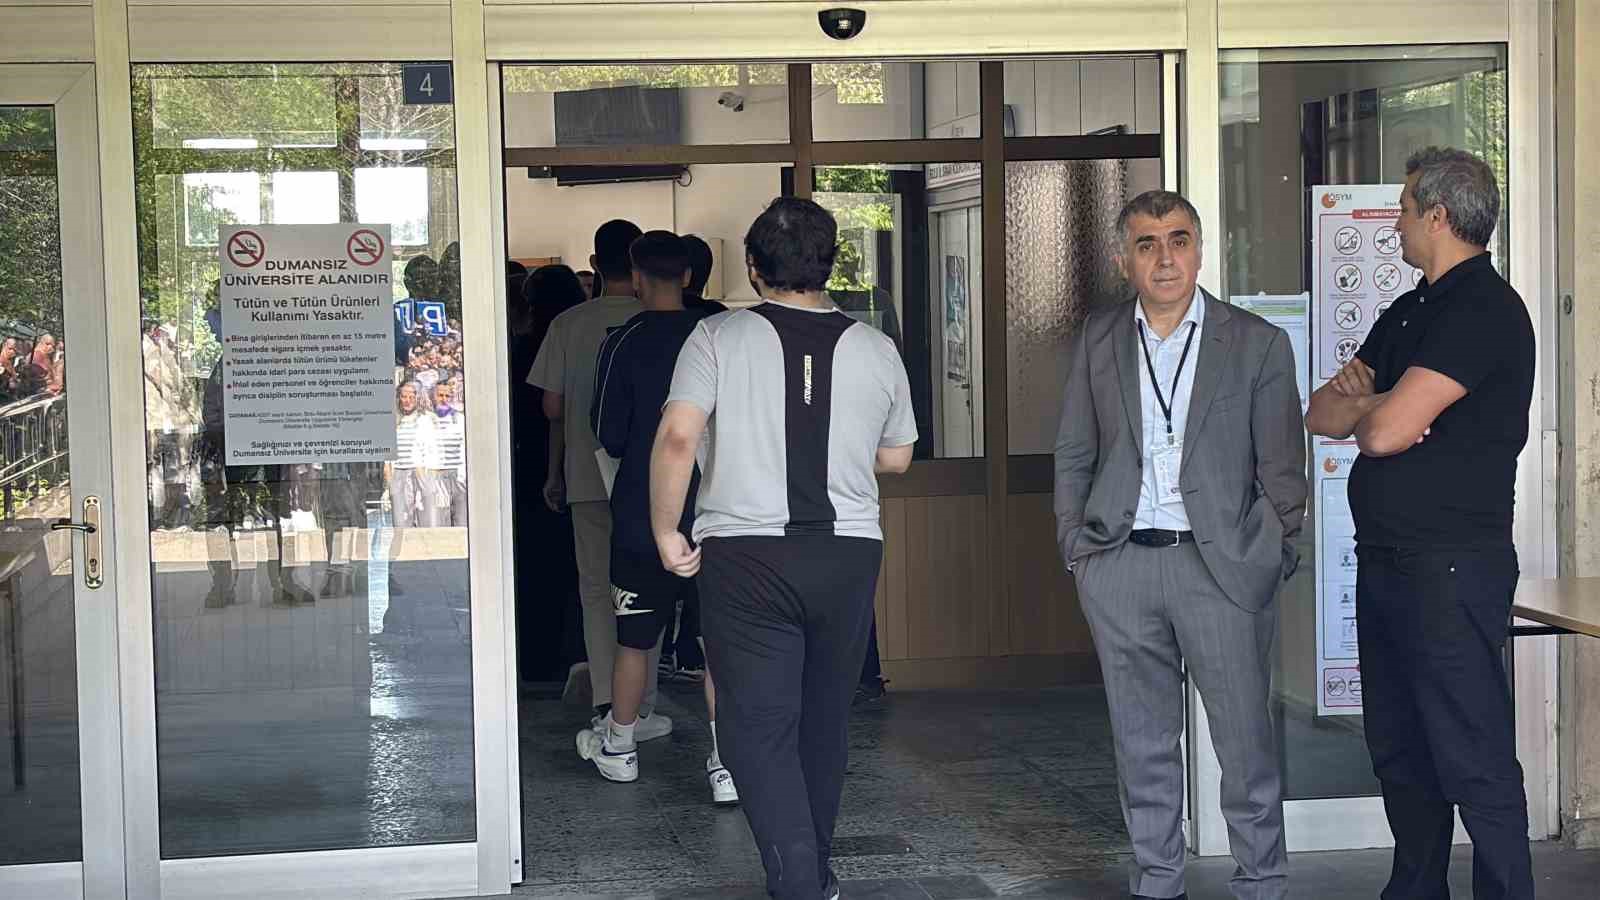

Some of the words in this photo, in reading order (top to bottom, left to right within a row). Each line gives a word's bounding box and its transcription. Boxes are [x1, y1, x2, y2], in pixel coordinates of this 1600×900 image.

[420, 72, 434, 97] 4
[265, 259, 347, 271] DUMANSIZ
[224, 273, 314, 286] ÜNİVERSİTE
[318, 273, 389, 285] ALANIDIR
[233, 297, 270, 309] Tütün
[273, 299, 288, 308] ve
[291, 296, 327, 308] Tütün
[330, 294, 380, 307] Ürünleri
[251, 311, 309, 322] Kullanımı
[313, 310, 364, 321] Yasaktır.
[271, 345, 295, 354] sigara
[296, 344, 320, 353] içmek
[231, 357, 254, 365] Yasak
[232, 368, 267, 377] hakkında
[269, 367, 286, 376] idari
[288, 368, 306, 377] para
[251, 380, 271, 388] eden
[272, 379, 306, 389] personel
[308, 379, 318, 387] ve
[250, 439, 293, 450] Sağlığınızı
[293, 440, 303, 448] ve
[304, 440, 339, 449] çevrenizi
[340, 439, 373, 448] koruyun
[232, 449, 271, 458] Dumansız
[273, 448, 312, 457] Üniversite
[314, 448, 328, 458] için
[329, 447, 364, 456] kurallara
